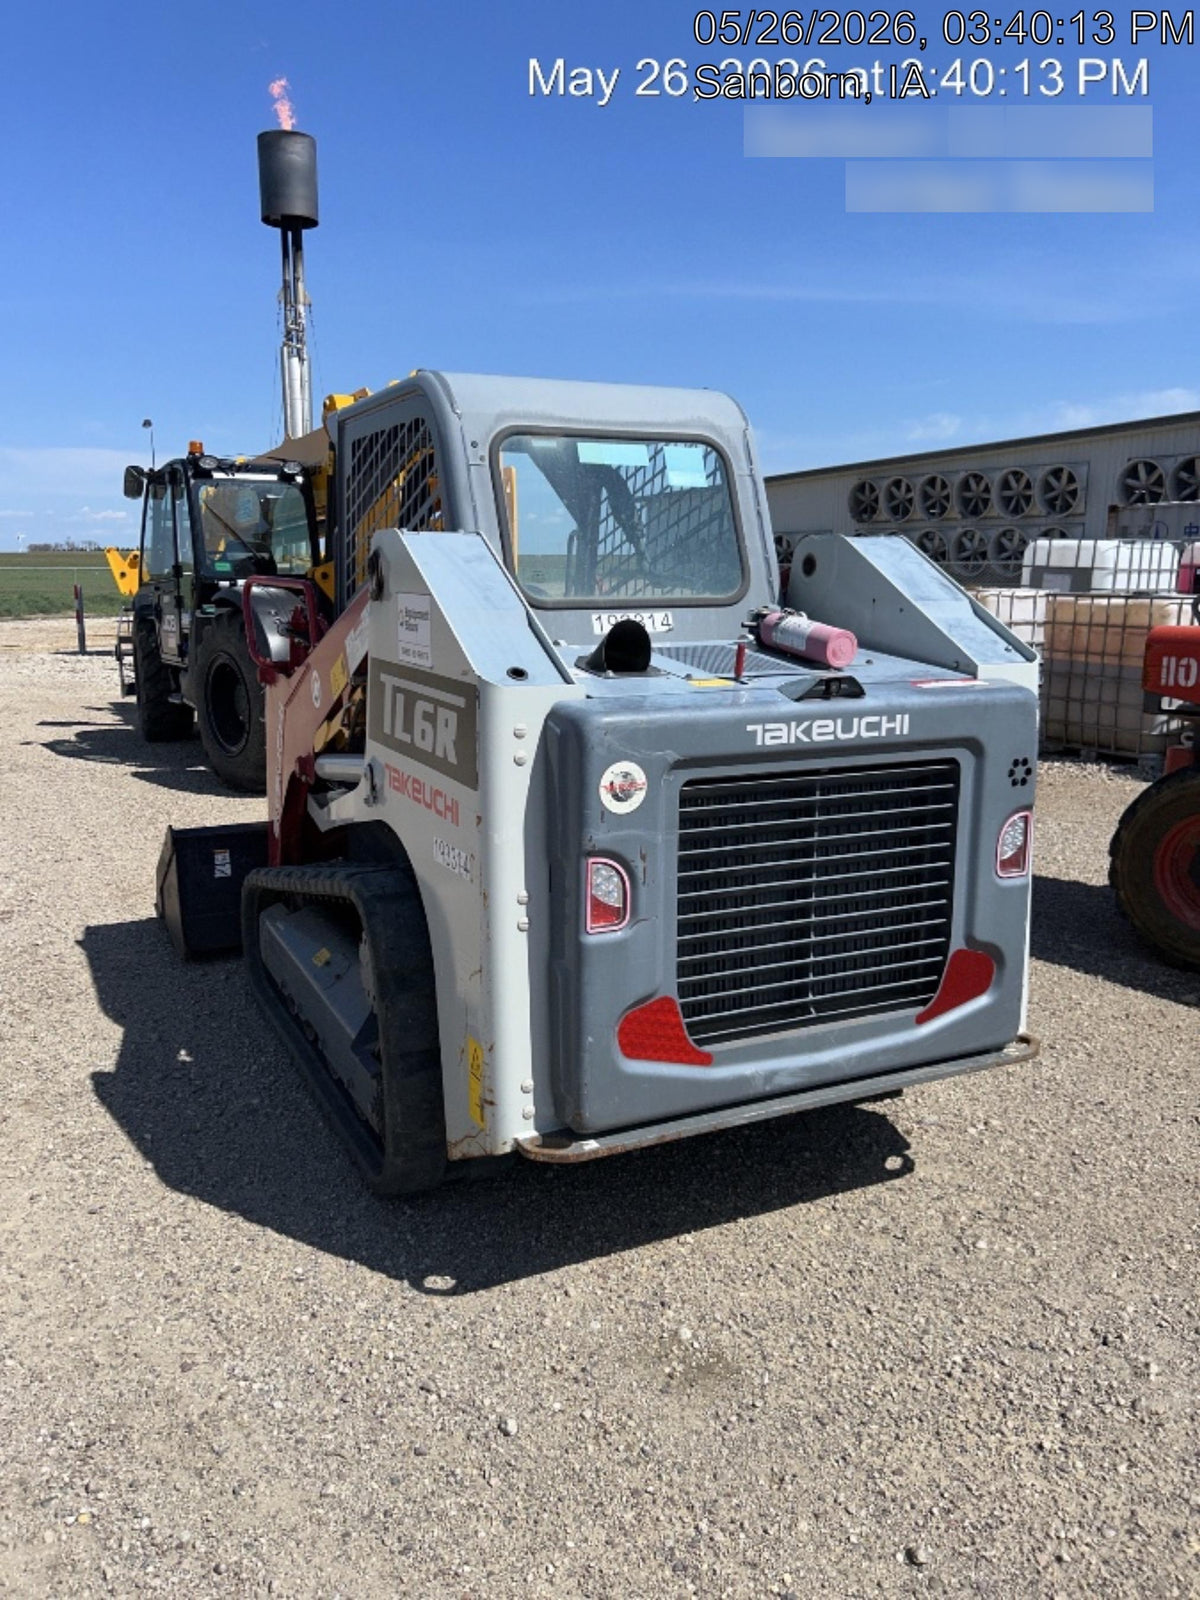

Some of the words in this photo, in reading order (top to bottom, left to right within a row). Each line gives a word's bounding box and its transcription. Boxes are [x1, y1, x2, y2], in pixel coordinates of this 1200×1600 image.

[380, 672, 466, 765] TL6R
[746, 714, 910, 746] TAKEUCHI
[385, 763, 460, 827] TAKEUCHI
